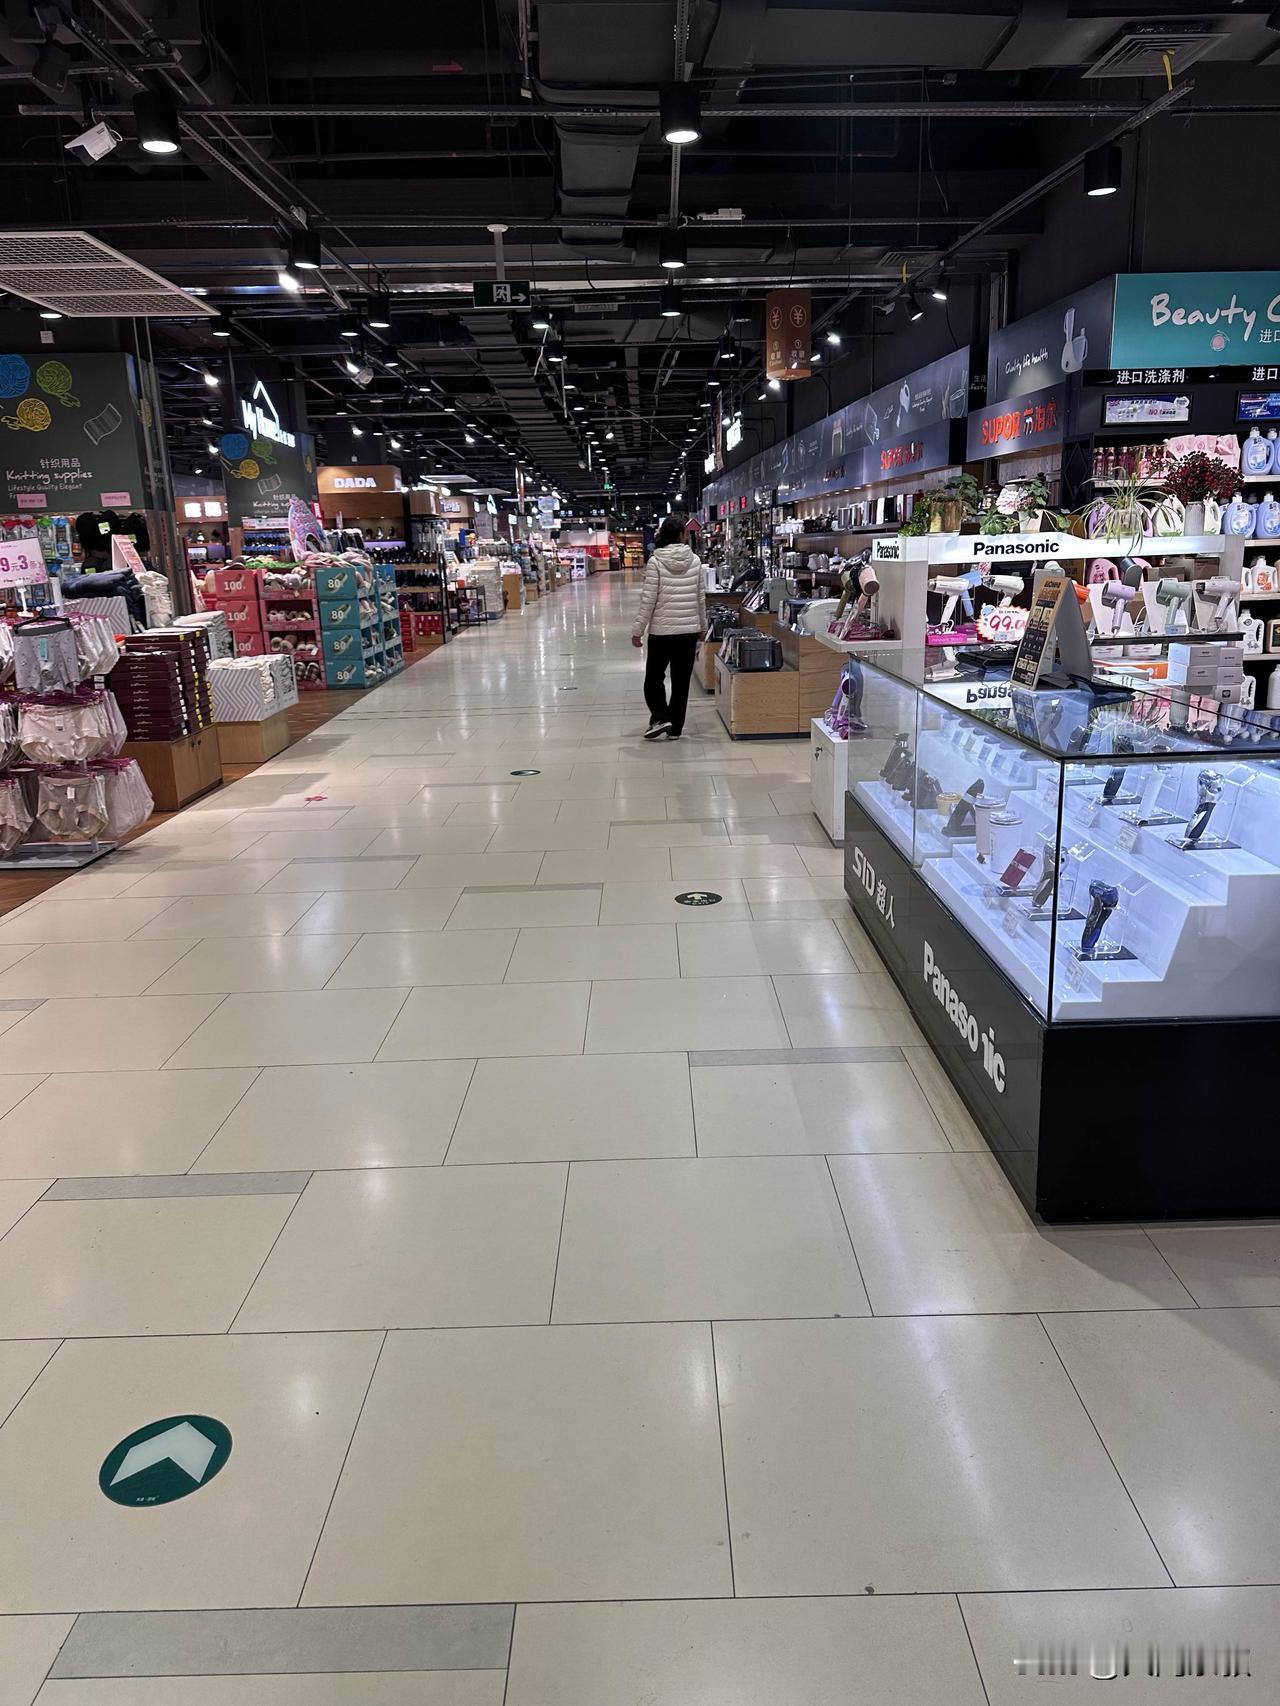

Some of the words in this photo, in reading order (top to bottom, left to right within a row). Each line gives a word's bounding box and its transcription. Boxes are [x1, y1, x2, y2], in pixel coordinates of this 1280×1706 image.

[1151, 292, 1257, 342] Beauty
[1116, 369, 1185, 385] 进口洗涤剂
[981, 411, 1022, 445] SUPOR
[40, 458, 81, 469] 针织用品
[6, 470, 51, 484] Knitting
[54, 469, 94, 483] supplies
[334, 477, 377, 488] DADA
[876, 541, 900, 560] Panasonic
[973, 539, 1060, 555] Panasonic
[224, 581, 243, 591] 100
[327, 579, 341, 589] 80
[228, 612, 247, 621] 100
[331, 610, 344, 620] 80
[333, 641, 346, 650] 80
[875, 879, 897, 929] 超人
